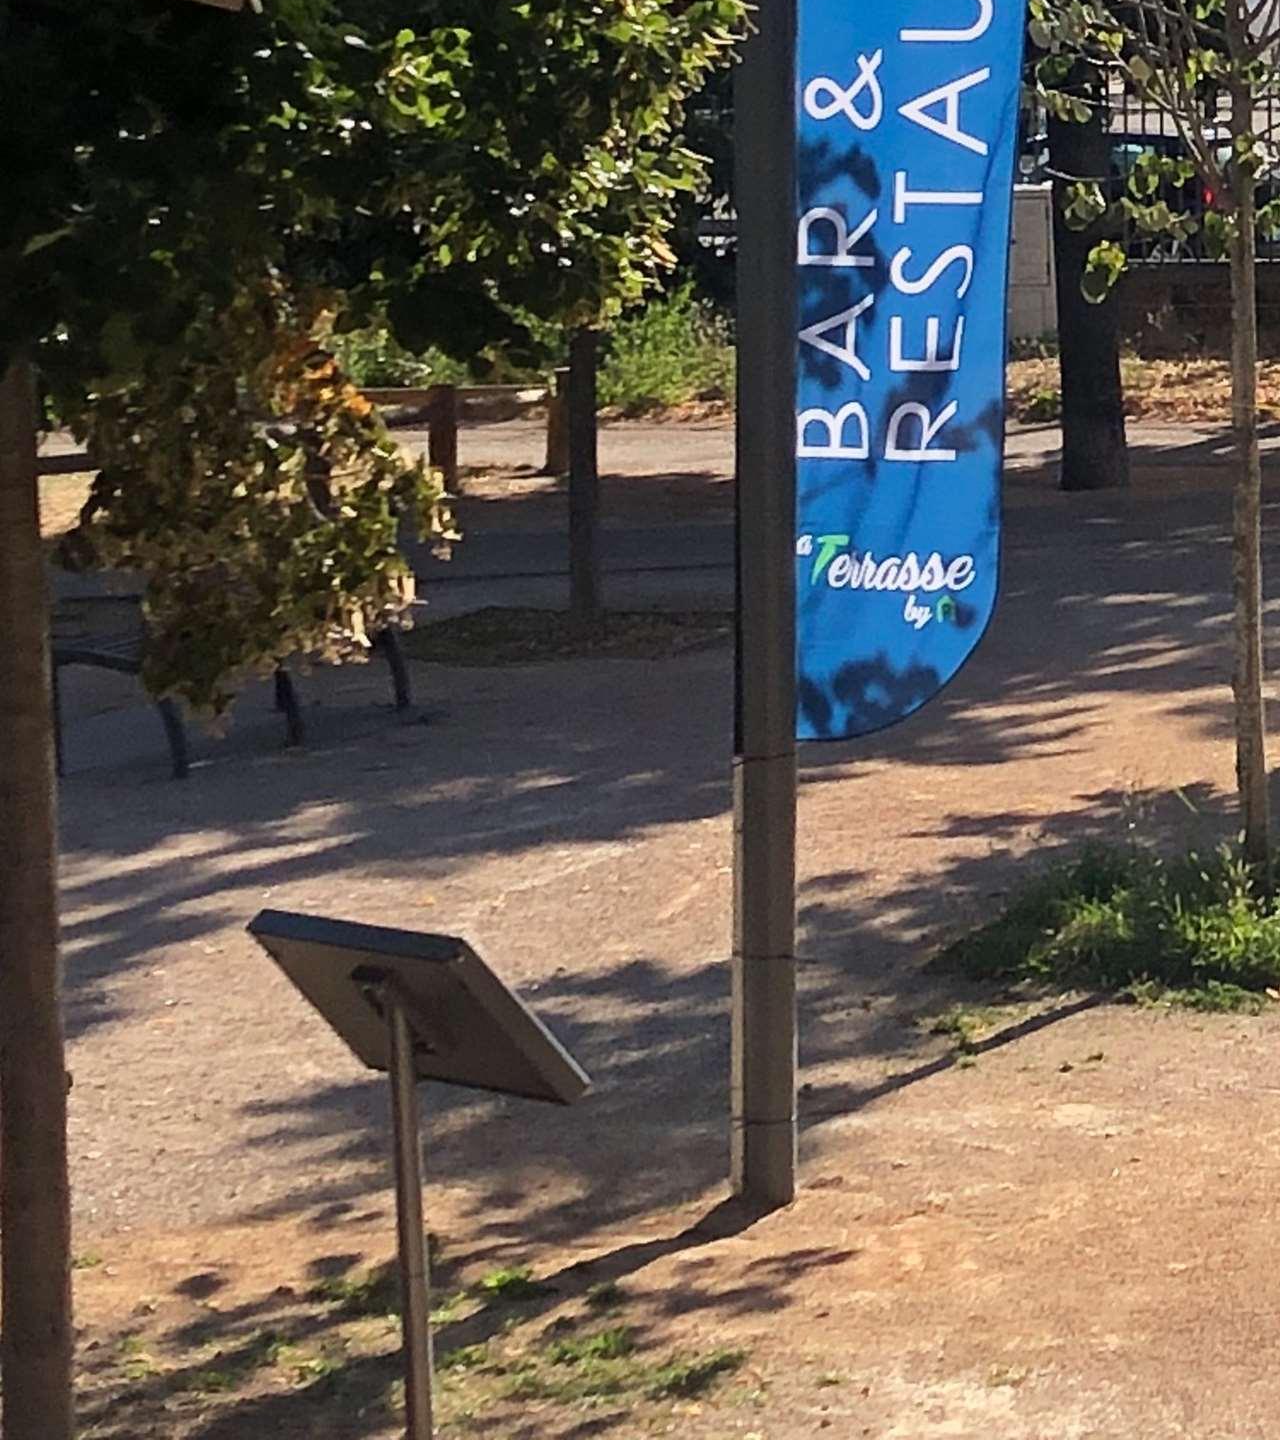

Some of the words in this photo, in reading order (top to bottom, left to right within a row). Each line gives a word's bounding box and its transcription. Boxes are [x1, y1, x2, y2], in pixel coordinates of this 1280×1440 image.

[804, 48, 883, 130] &
[797, 207, 878, 459] BAR
[811, 534, 977, 591] Terrasse
[904, 594, 933, 630] by
